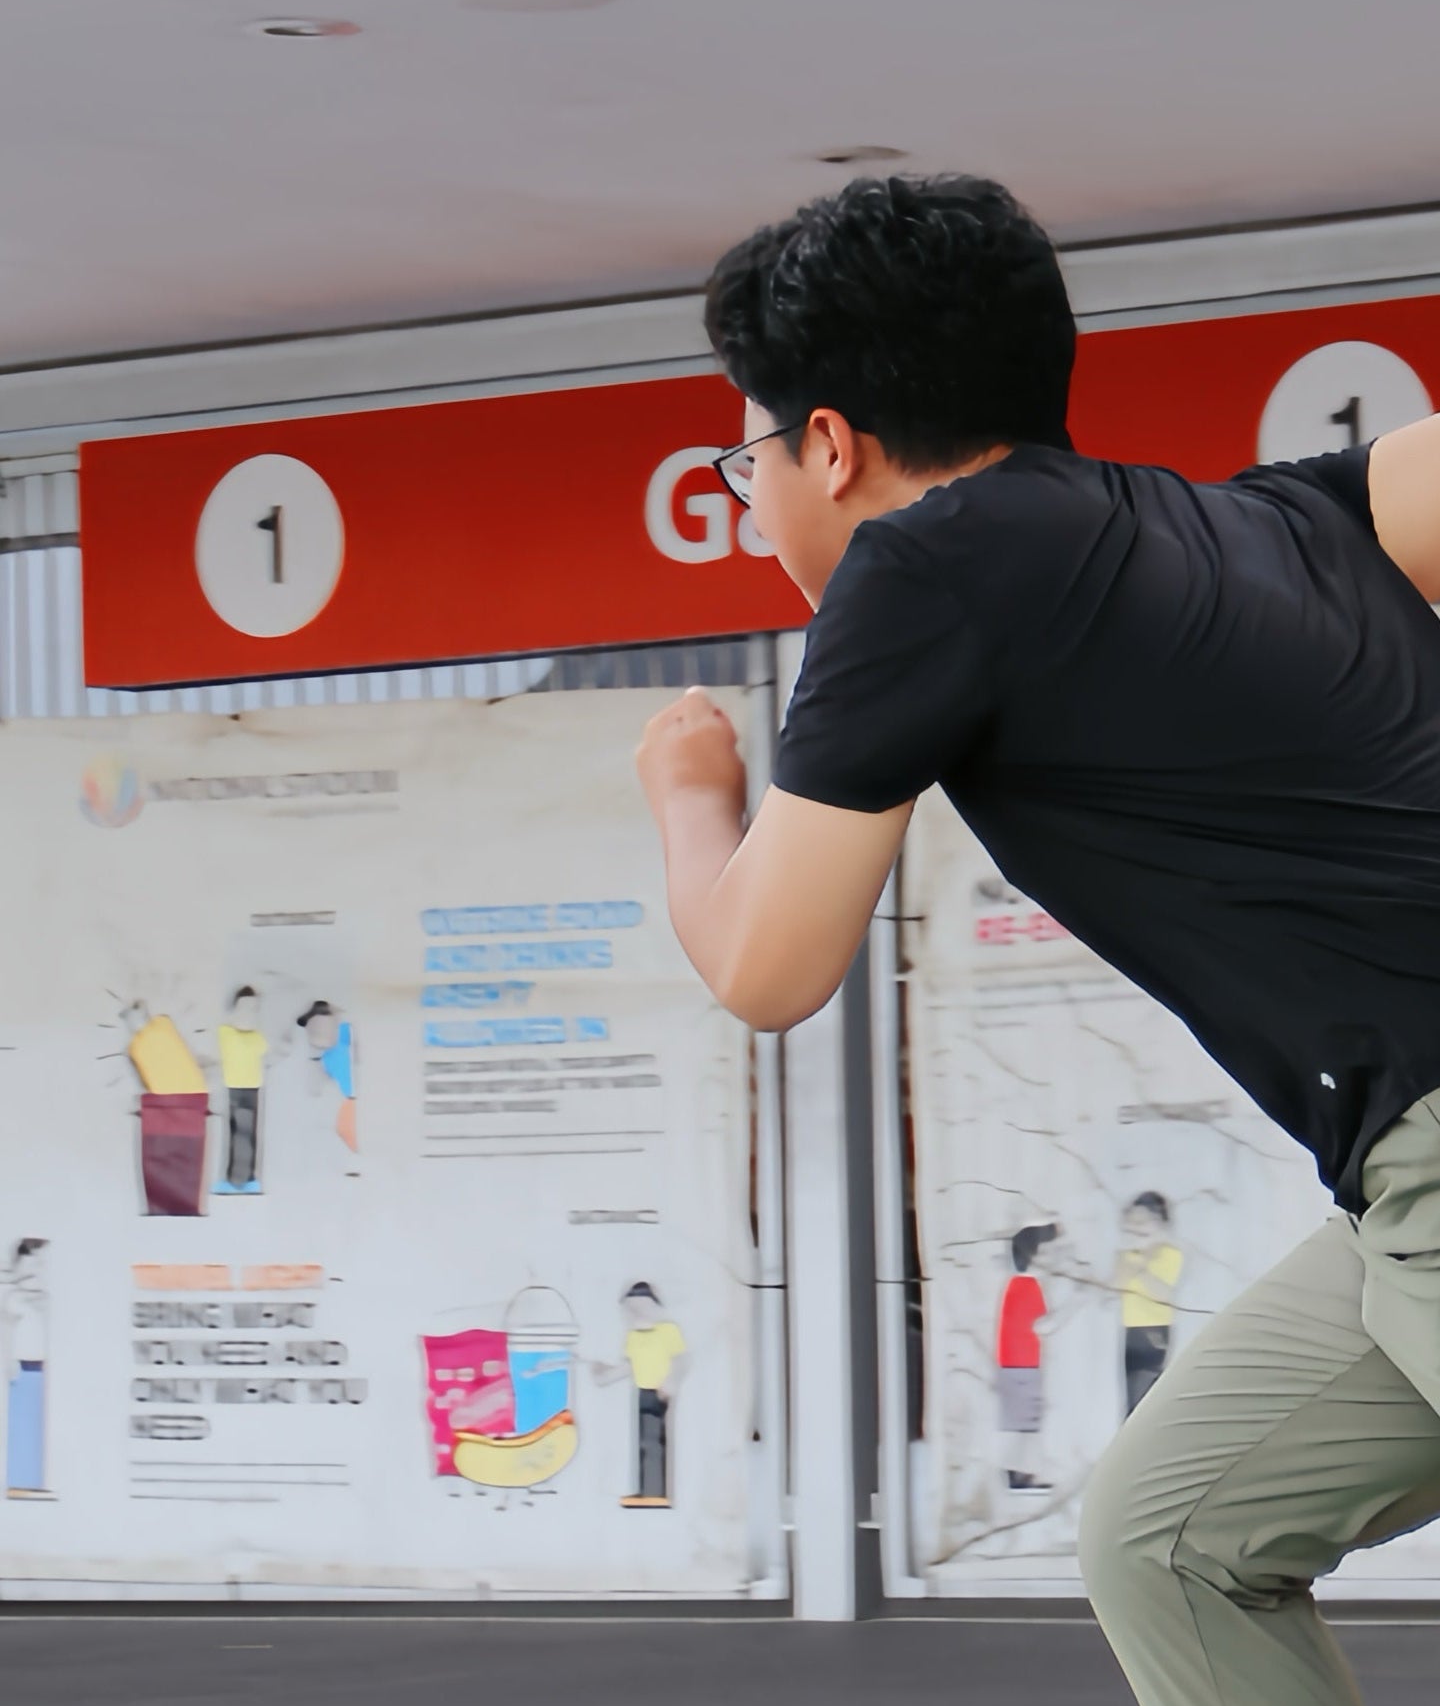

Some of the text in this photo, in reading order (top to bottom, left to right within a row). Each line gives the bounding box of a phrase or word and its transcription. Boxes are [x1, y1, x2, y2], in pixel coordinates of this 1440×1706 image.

[1330, 396, 1361, 447] 1
[257, 505, 283, 584] 1
[128, 1414, 212, 1441] NEED
